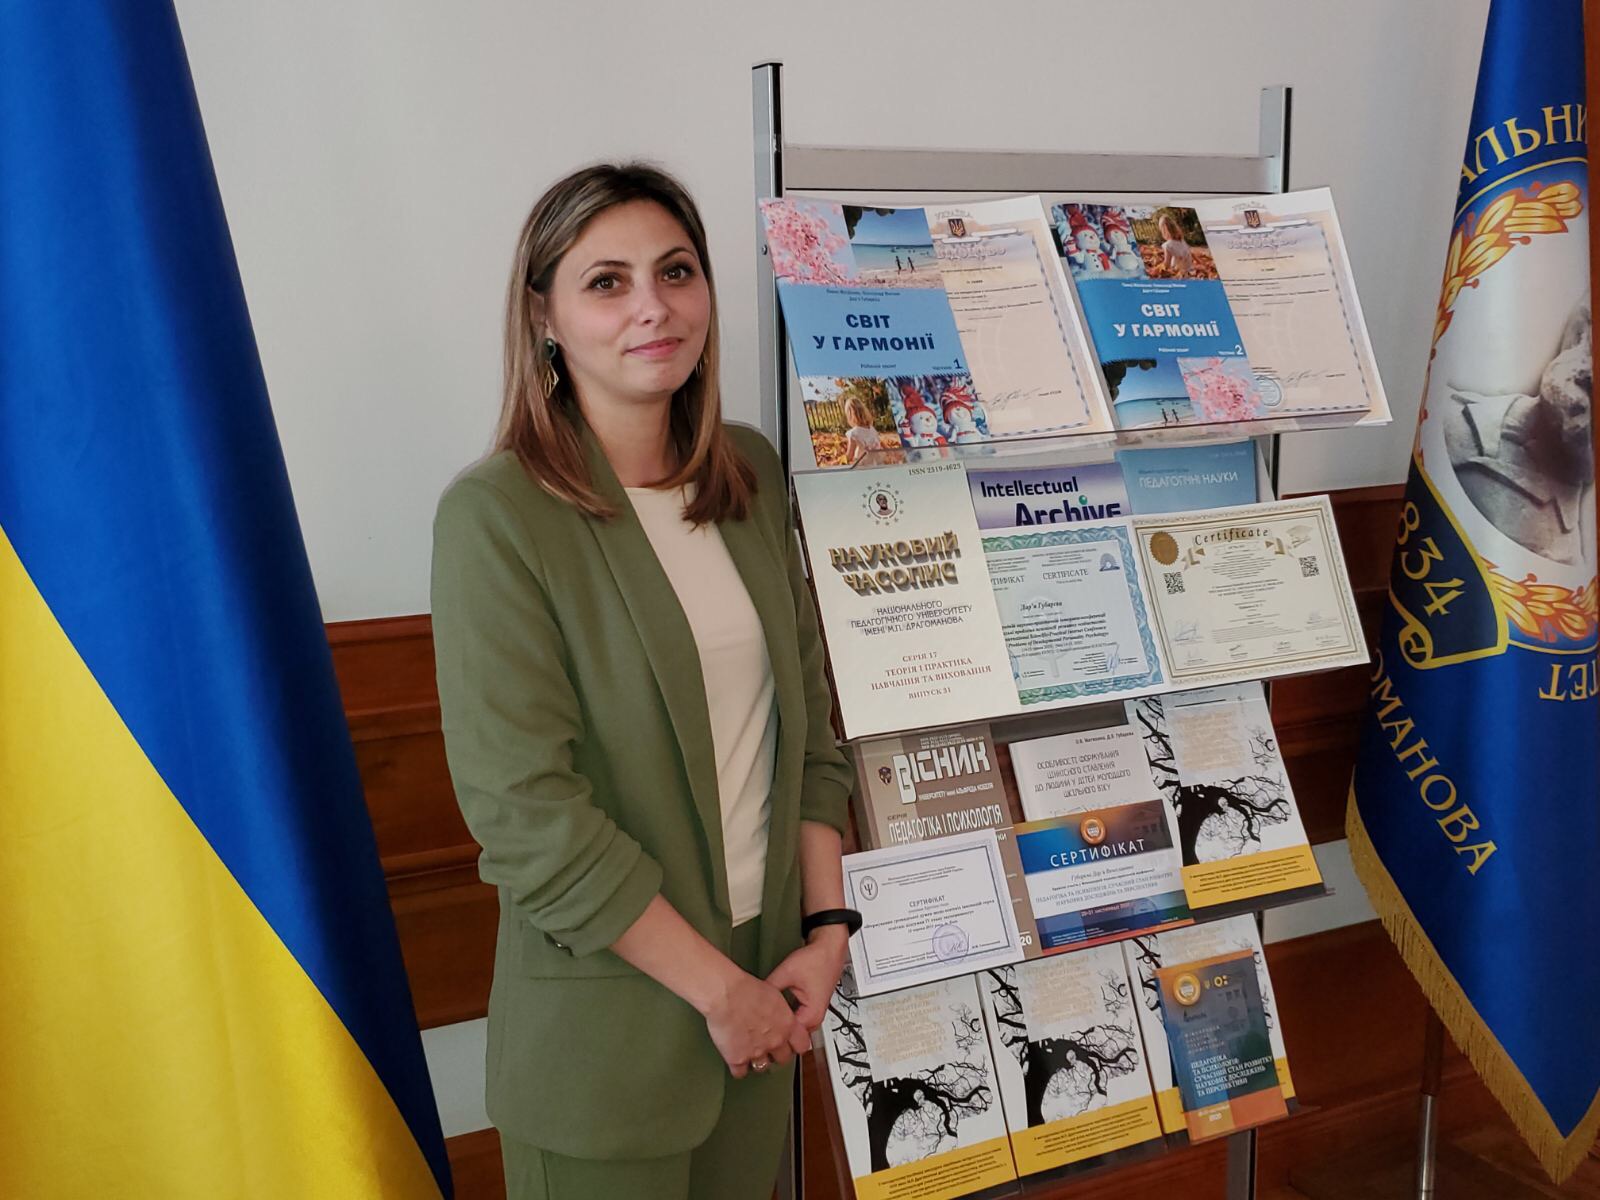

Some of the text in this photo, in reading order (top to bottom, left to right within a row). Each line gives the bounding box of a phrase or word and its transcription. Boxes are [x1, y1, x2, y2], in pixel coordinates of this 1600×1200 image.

[1141, 303, 1181, 317] СВІТ
[845, 313, 891, 329] СВІТ
[1113, 320, 1220, 337] У ГАРМОНІЇ
[812, 332, 935, 351] У ГАРМОНІЇ
[1235, 344, 1245, 356] 2
[953, 357, 964, 370] 1
[908, 465, 926, 476] ISSN
[1139, 475, 1201, 489] ПЕДАГОГІЧНІ
[1201, 471, 1239, 485] НАУКИ
[981, 475, 1080, 499] Intellectual
[1194, 526, 1270, 546] Certificate
[828, 530, 962, 573] НАУКОВИЙ
[1396, 500, 1466, 618] 834
[842, 561, 959, 597] ЧАСОПИС
[1042, 568, 1089, 582] CERTIFICATE
[850, 604, 973, 629] ПЕДАГОГІЧНОГО УНІВЕРСИТЕТУ
[876, 600, 943, 616] НАЦІОНАЛЬНОГО
[863, 616, 965, 637] ІМЕНІ М.П. ДРАГОМАНОВА
[902, 651, 938, 663] СЕРІЯ 17
[886, 665, 918, 678] ТЕОРІЯ
[926, 658, 973, 672] ПРАКТИКА
[871, 665, 992, 691] НАВЧАННЯ ТА ВИХОВАННЯ
[909, 689, 942, 700] ВИПУСК
[1037, 749, 1120, 771] ОСОБЛИВОСТІ ФОРМУВАННЯ
[1083, 760, 1117, 774] СТАВЛЕННЯ
[892, 741, 991, 805] ВІСНИК
[1034, 783, 1044, 793] ДО
[1045, 777, 1071, 791] ЛЮДИНИ
[1078, 774, 1096, 786] ДІТЕЙ
[1096, 768, 1132, 782] МОЛОДШОГО
[1064, 783, 1112, 798] ШКІЛЬНОГО ВІКУ
[887, 812, 908, 822] СЕРІЯ
[888, 814, 943, 845] ПЕДАГОГІКА
[946, 804, 1004, 833] ПСИХОЛОГІЯ
[1050, 838, 1145, 868] СЕРТИФІКАТ
[908, 895, 946, 909] СЕРТИФІКАТ
[1190, 1053, 1228, 1070] ПЕДАГОГІКА
[1193, 1055, 1274, 1083] СУЧАСНИЙ СТАН РОЗВИТКУ
[1192, 1067, 1202, 1077] ТА
[1195, 1065, 1267, 1091] НАУКОВИХ ДОСЛІДЖЕНЬ
[1197, 1077, 1248, 1098] ТА ПЕРСПЕКТИВИ
